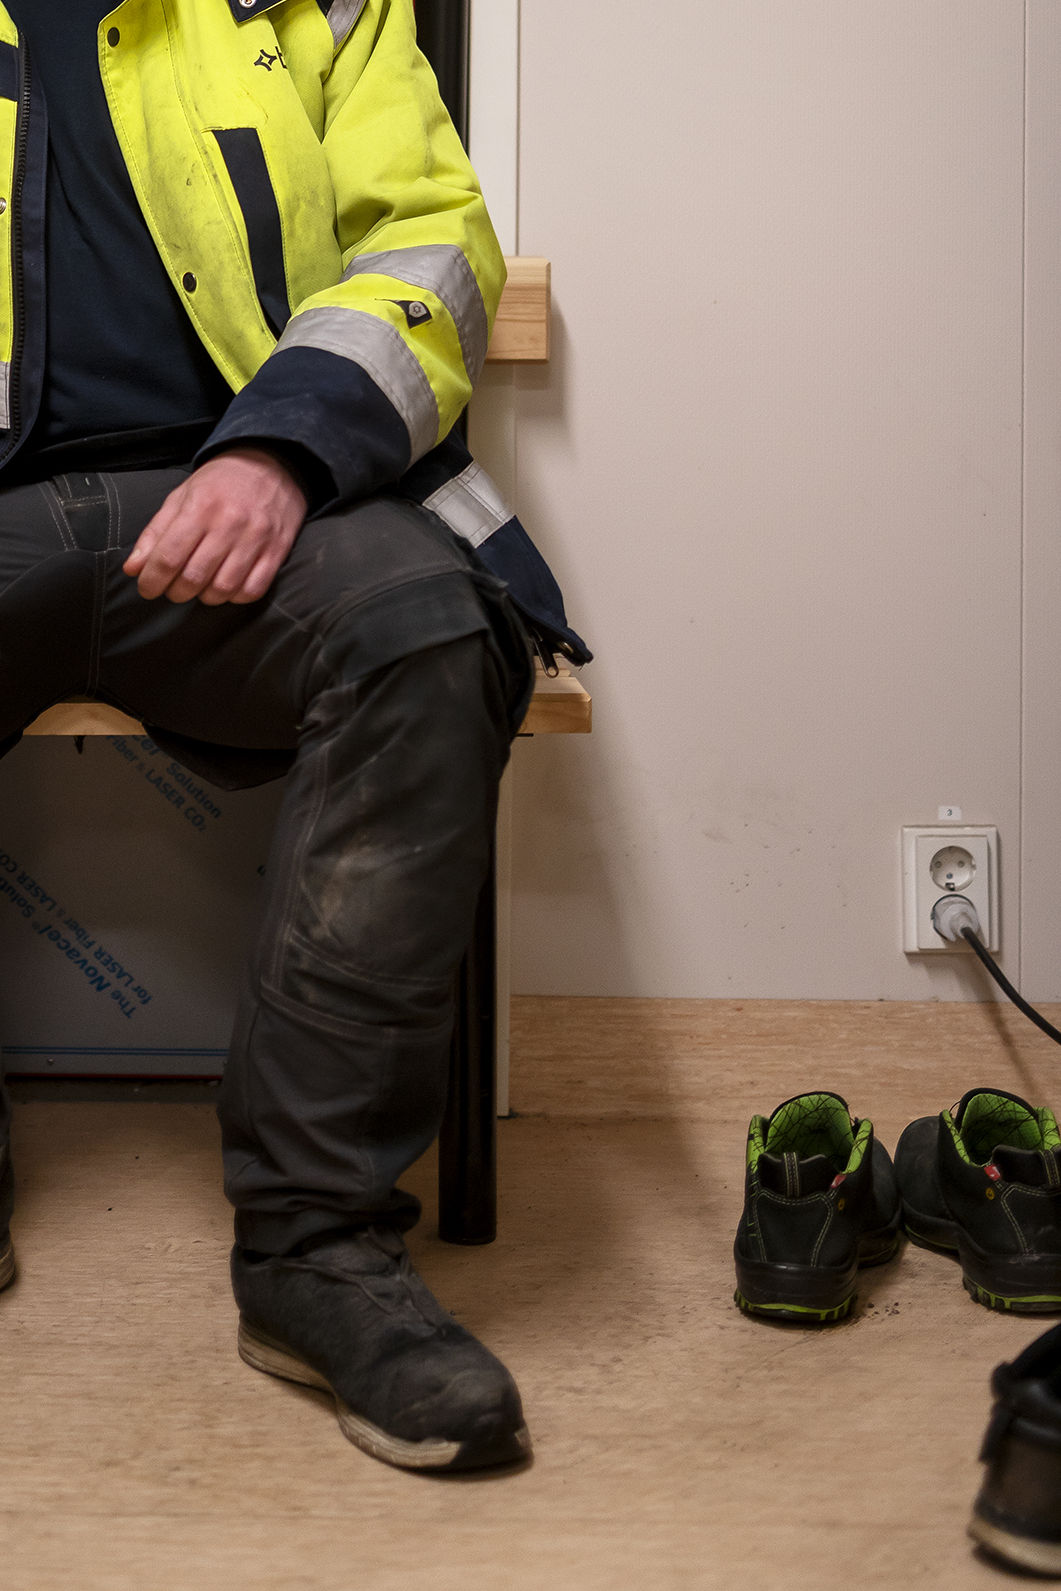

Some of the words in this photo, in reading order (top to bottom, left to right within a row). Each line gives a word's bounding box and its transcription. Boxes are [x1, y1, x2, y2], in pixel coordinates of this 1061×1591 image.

[145, 768, 186, 809] LASER
[166, 762, 222, 819] Solution
[16, 869, 58, 912] LASER
[63, 915, 97, 950] Fiber
[93, 944, 135, 987] LASER
[110, 987, 137, 1019] The
[128, 981, 153, 1006] for
